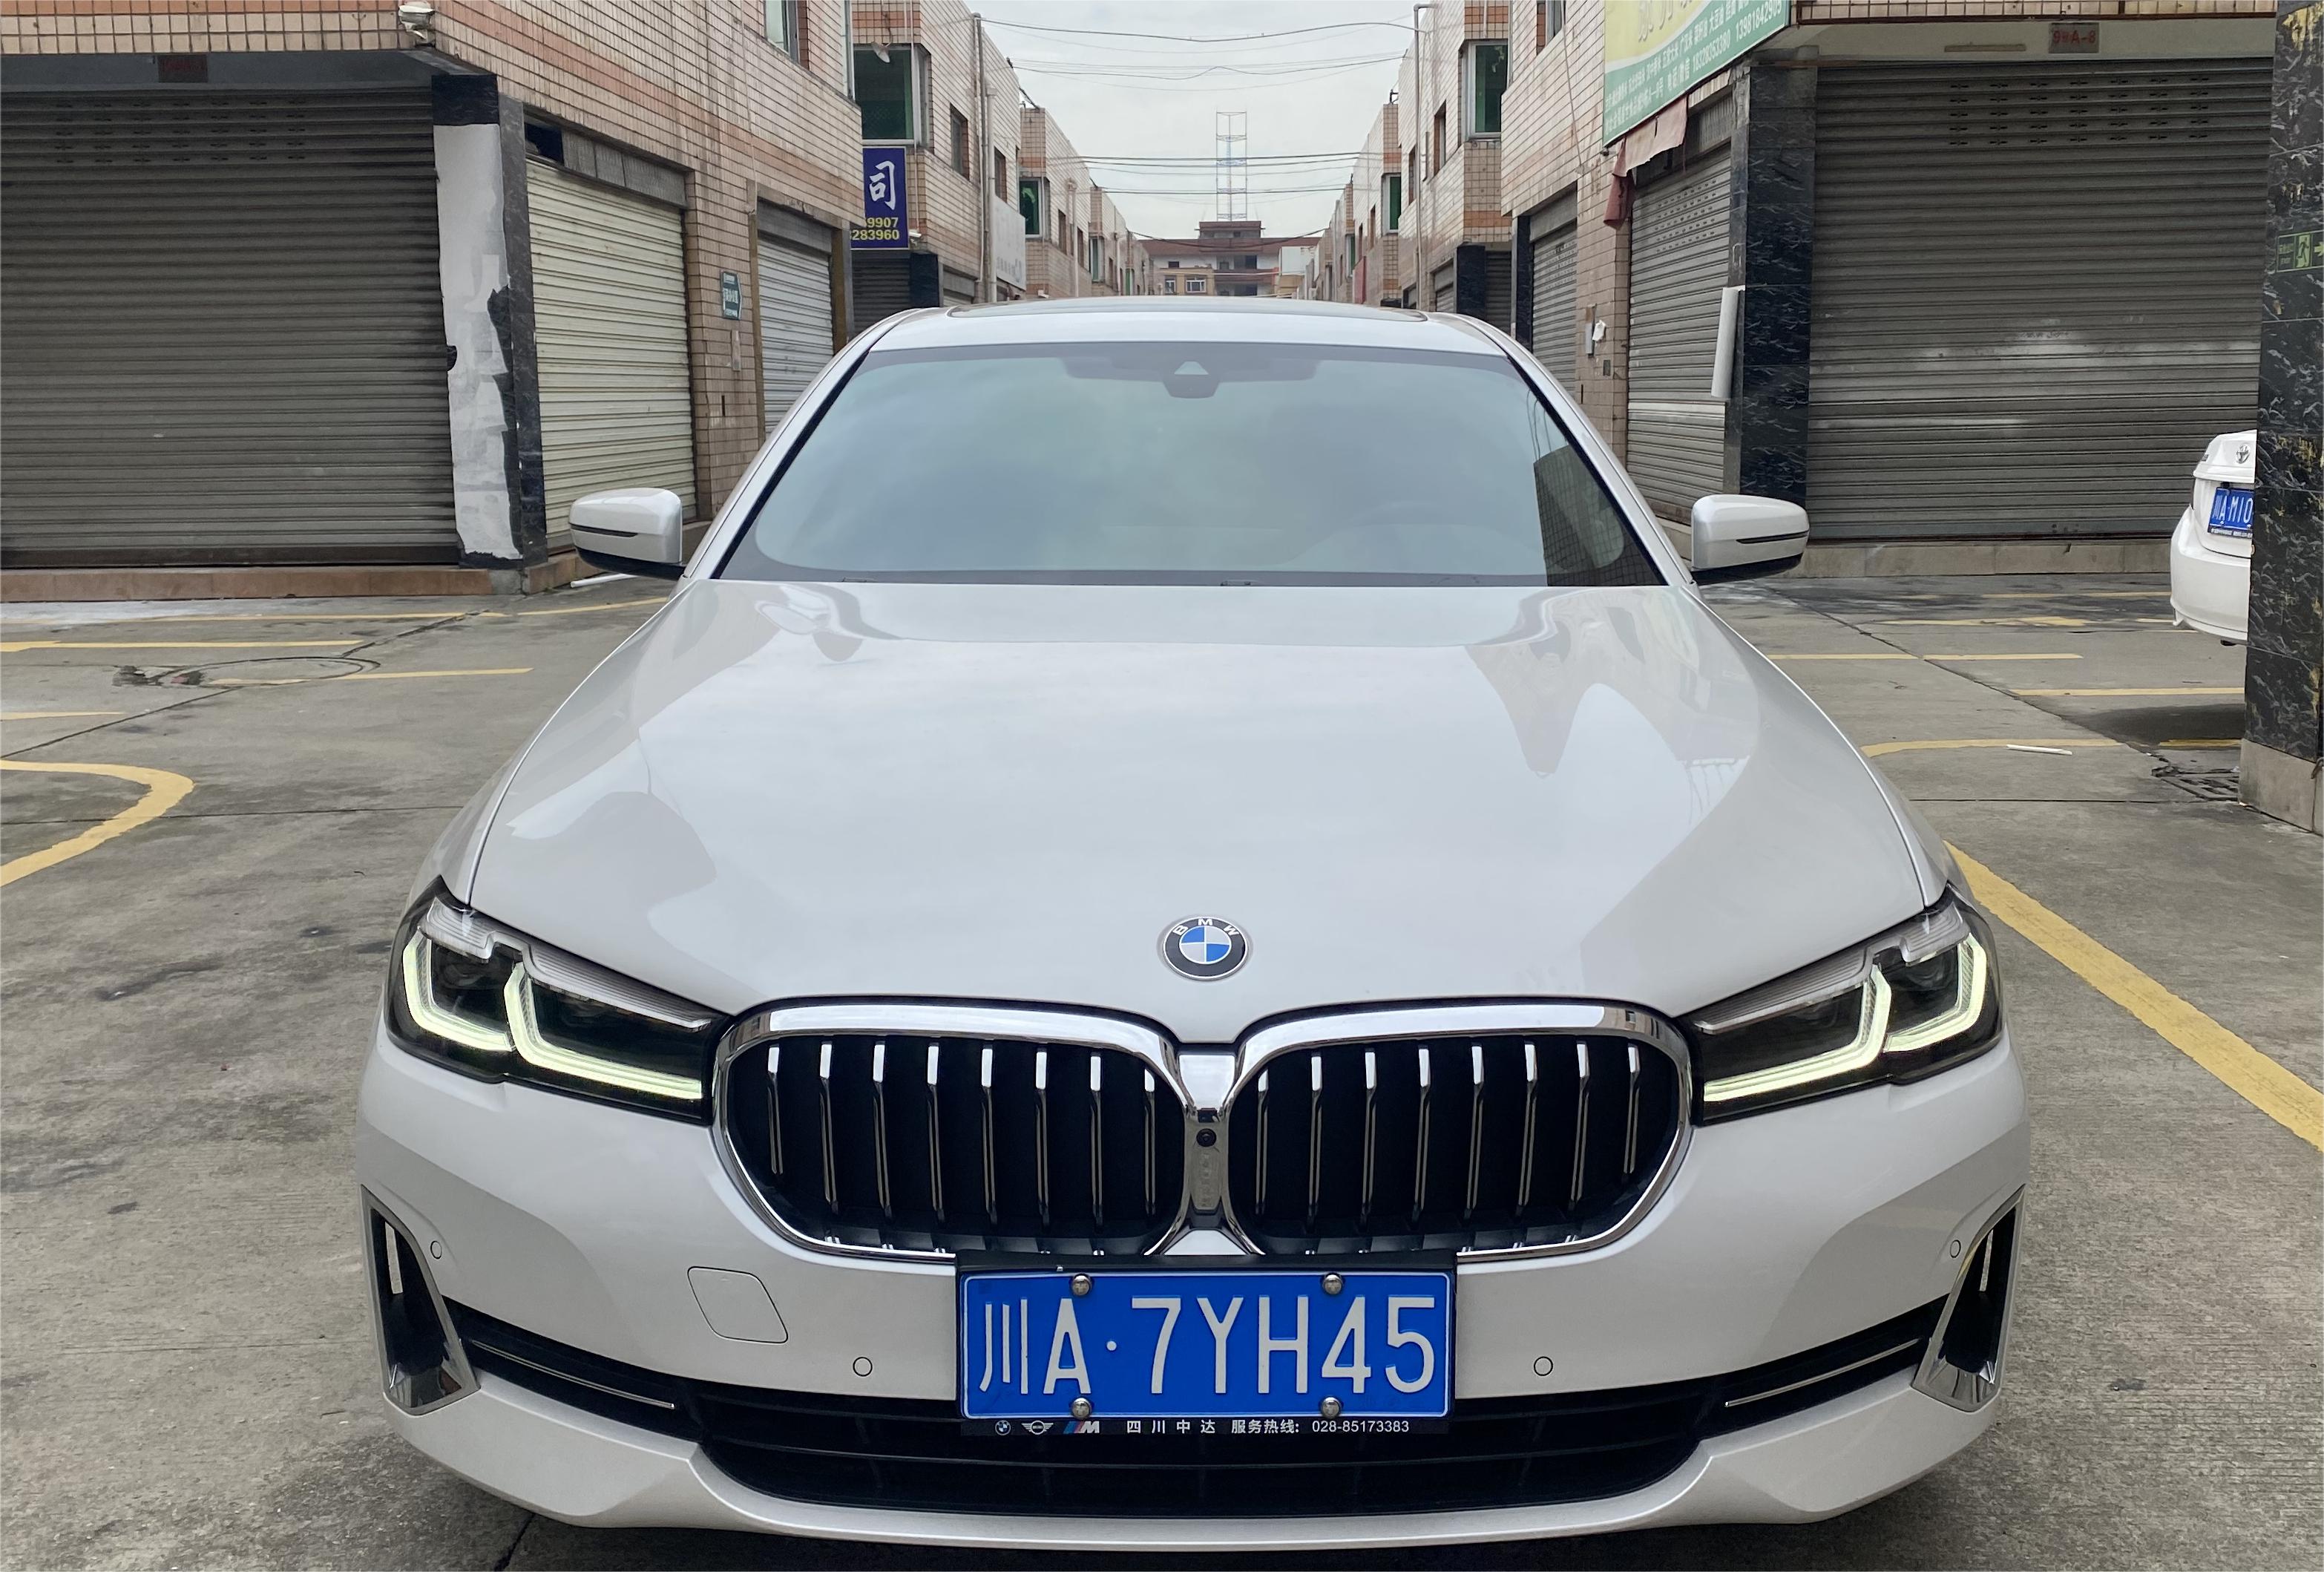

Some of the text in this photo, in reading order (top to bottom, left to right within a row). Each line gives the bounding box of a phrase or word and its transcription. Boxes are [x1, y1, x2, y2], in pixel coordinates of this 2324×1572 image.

[869, 160, 896, 210] 司
[866, 217, 899, 228] 9907
[850, 229, 900, 240] 283960
[1172, 917, 1240, 936] BMW
[1312, 1420, 1410, 1433] 028-85173383
